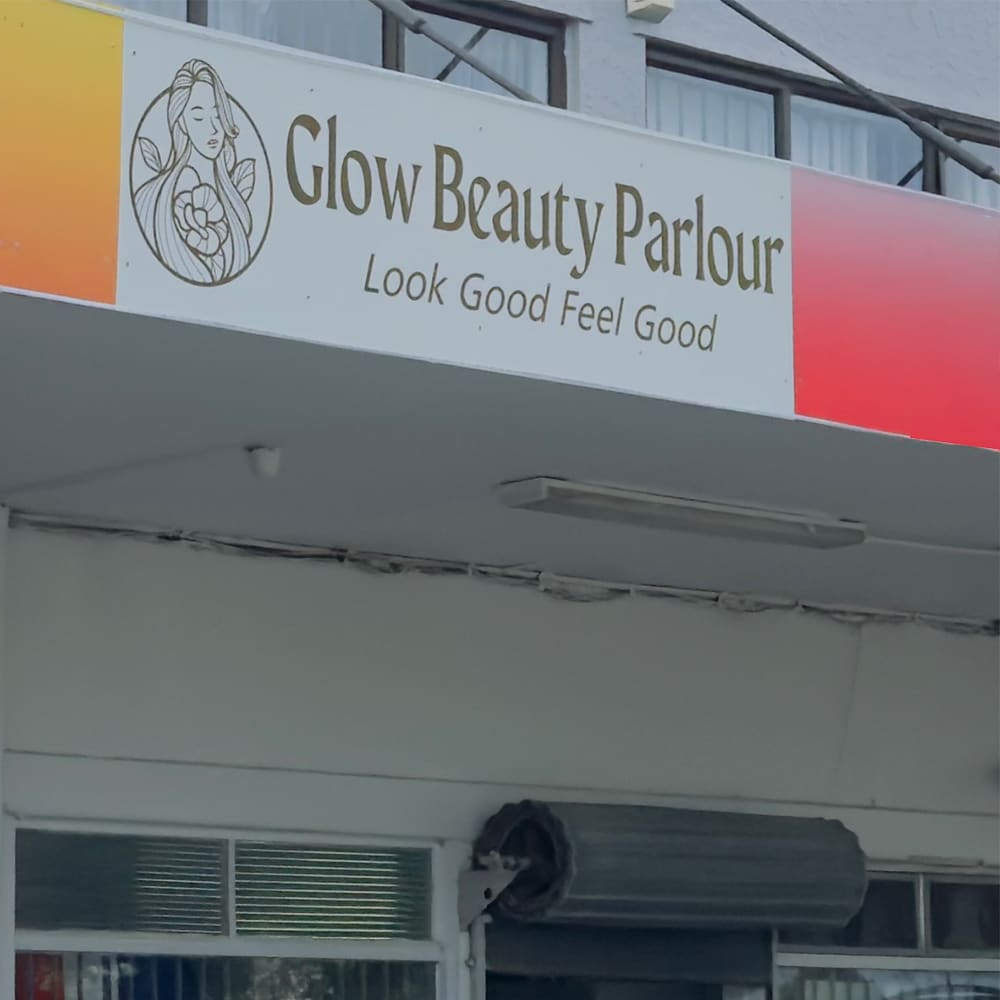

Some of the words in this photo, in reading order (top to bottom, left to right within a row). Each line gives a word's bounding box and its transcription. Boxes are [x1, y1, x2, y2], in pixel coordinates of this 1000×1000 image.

[285, 114, 422, 224] Glow
[433, 144, 604, 278] Beauty
[614, 183, 785, 294] Parlour
[364, 253, 448, 305] Look
[460, 273, 551, 322] Good
[560, 290, 624, 336] Feel
[633, 304, 718, 352] Good
